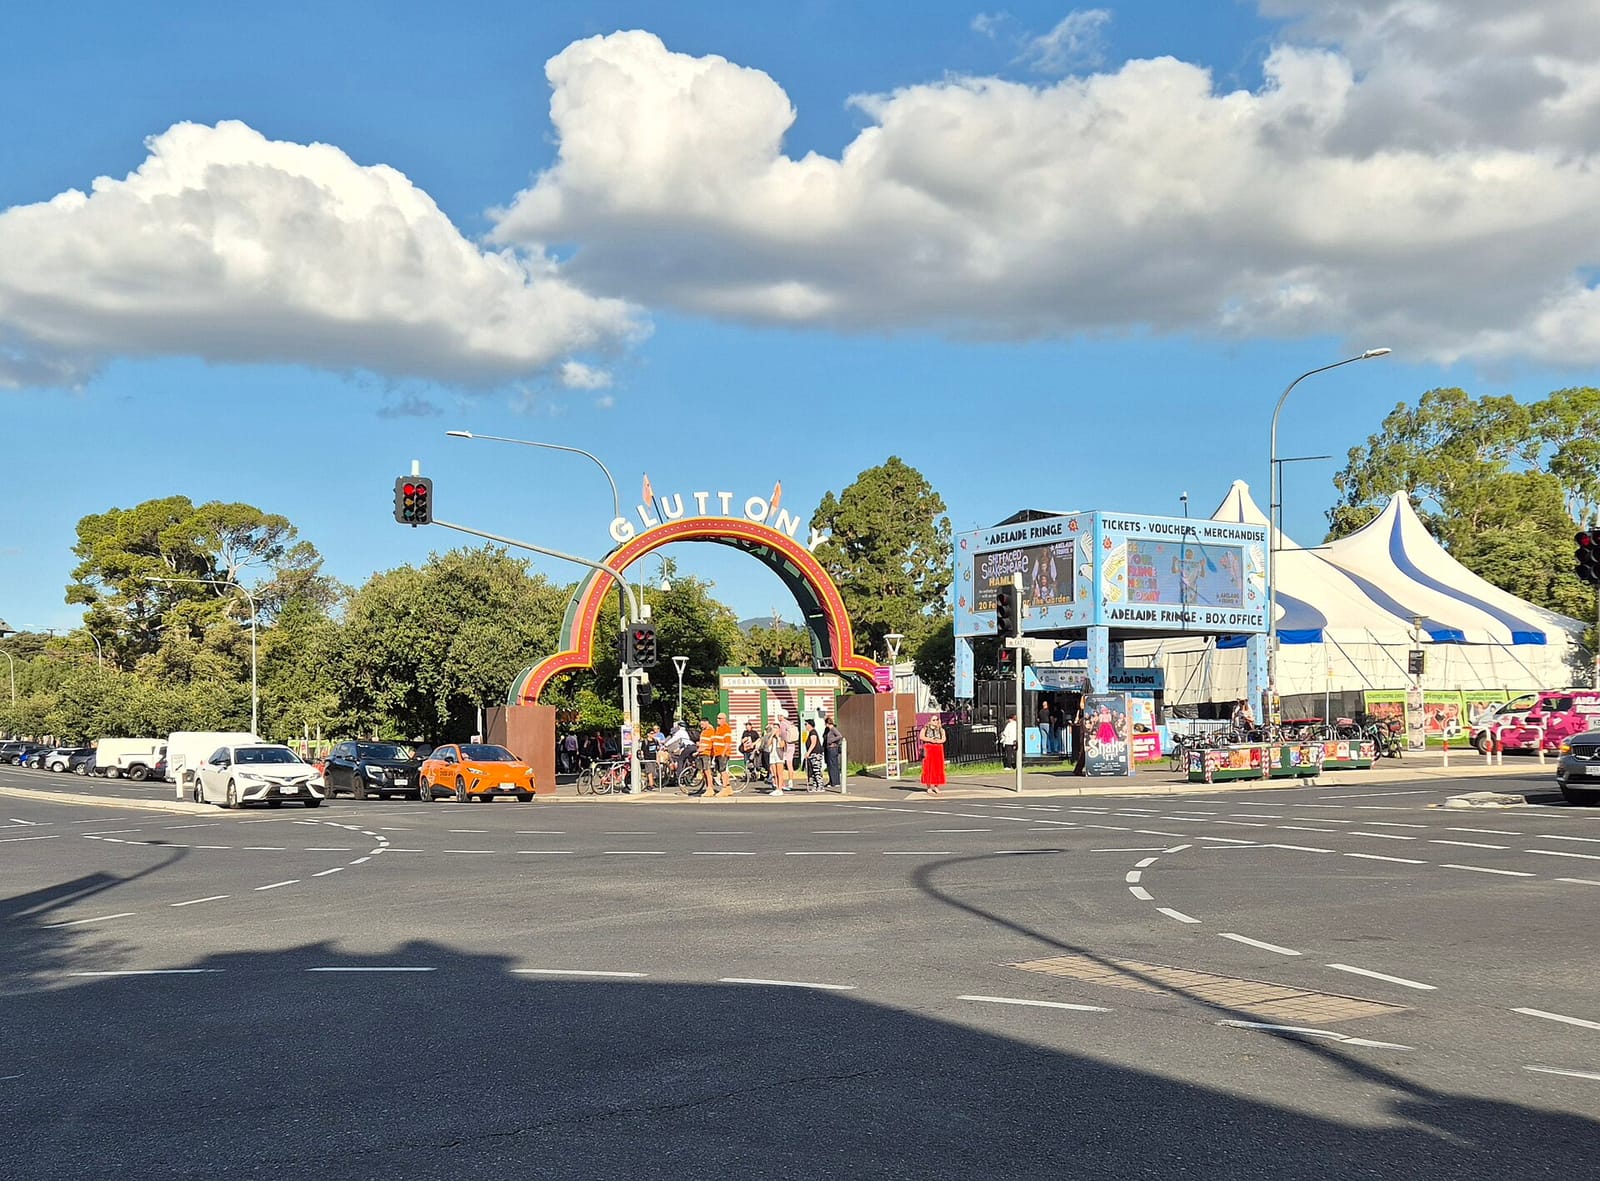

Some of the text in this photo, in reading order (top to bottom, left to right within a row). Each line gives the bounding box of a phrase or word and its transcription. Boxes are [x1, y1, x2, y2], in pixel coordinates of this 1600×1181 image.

[609, 491, 829, 552] GLUTTONY
[1102, 519, 1265, 542] TICKETS VOUCHERS MERCHANDISE
[989, 523, 1063, 545] ADELAIDE FRINGE
[1110, 609, 1263, 626] ADELAIDE FRINGE BOX OFFICE
[764, 678, 785, 686] TODAY
[1087, 738, 1126, 759] Shake
